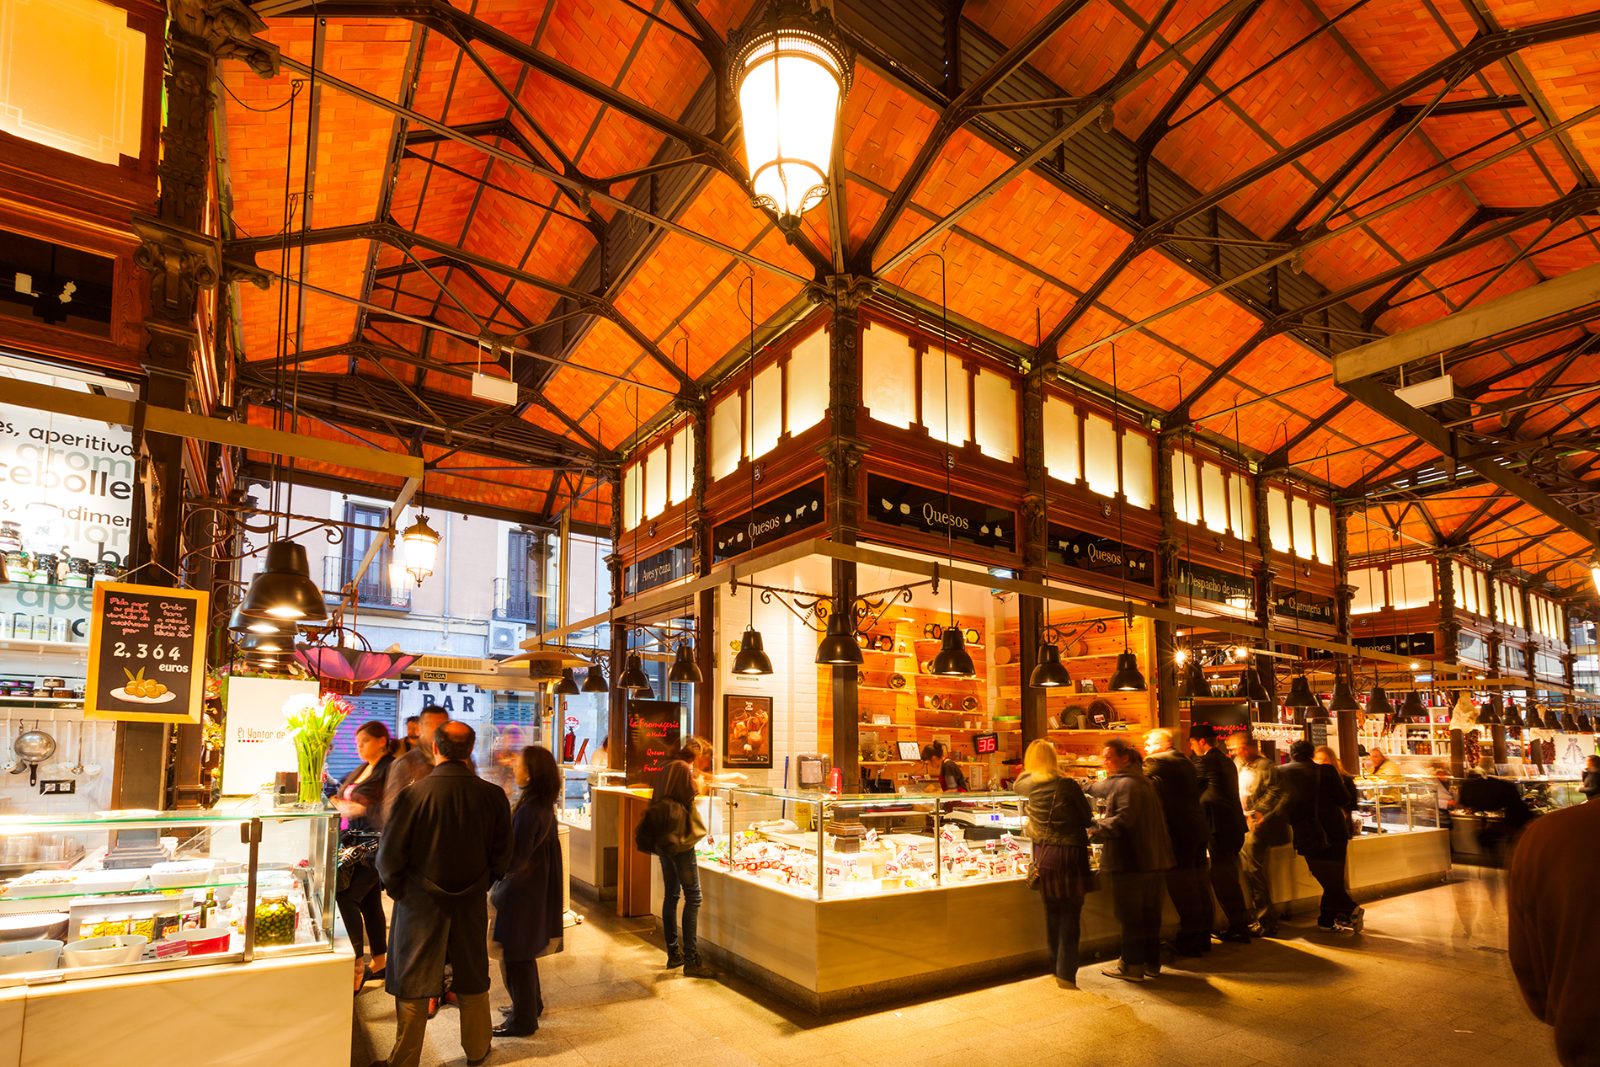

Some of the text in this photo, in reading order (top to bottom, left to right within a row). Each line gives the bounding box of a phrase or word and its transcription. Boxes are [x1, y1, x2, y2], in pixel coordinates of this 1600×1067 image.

[922, 502, 969, 529] Quesos
[748, 515, 780, 540] Quesos
[1087, 543, 1121, 565] Quesos
[1187, 572, 1221, 593] Despacho
[1222, 581, 1230, 594] de
[160, 602, 187, 611] Order
[158, 663, 189, 673] euros
[423, 694, 474, 712] BAR
[978, 739, 995, 752] 36
